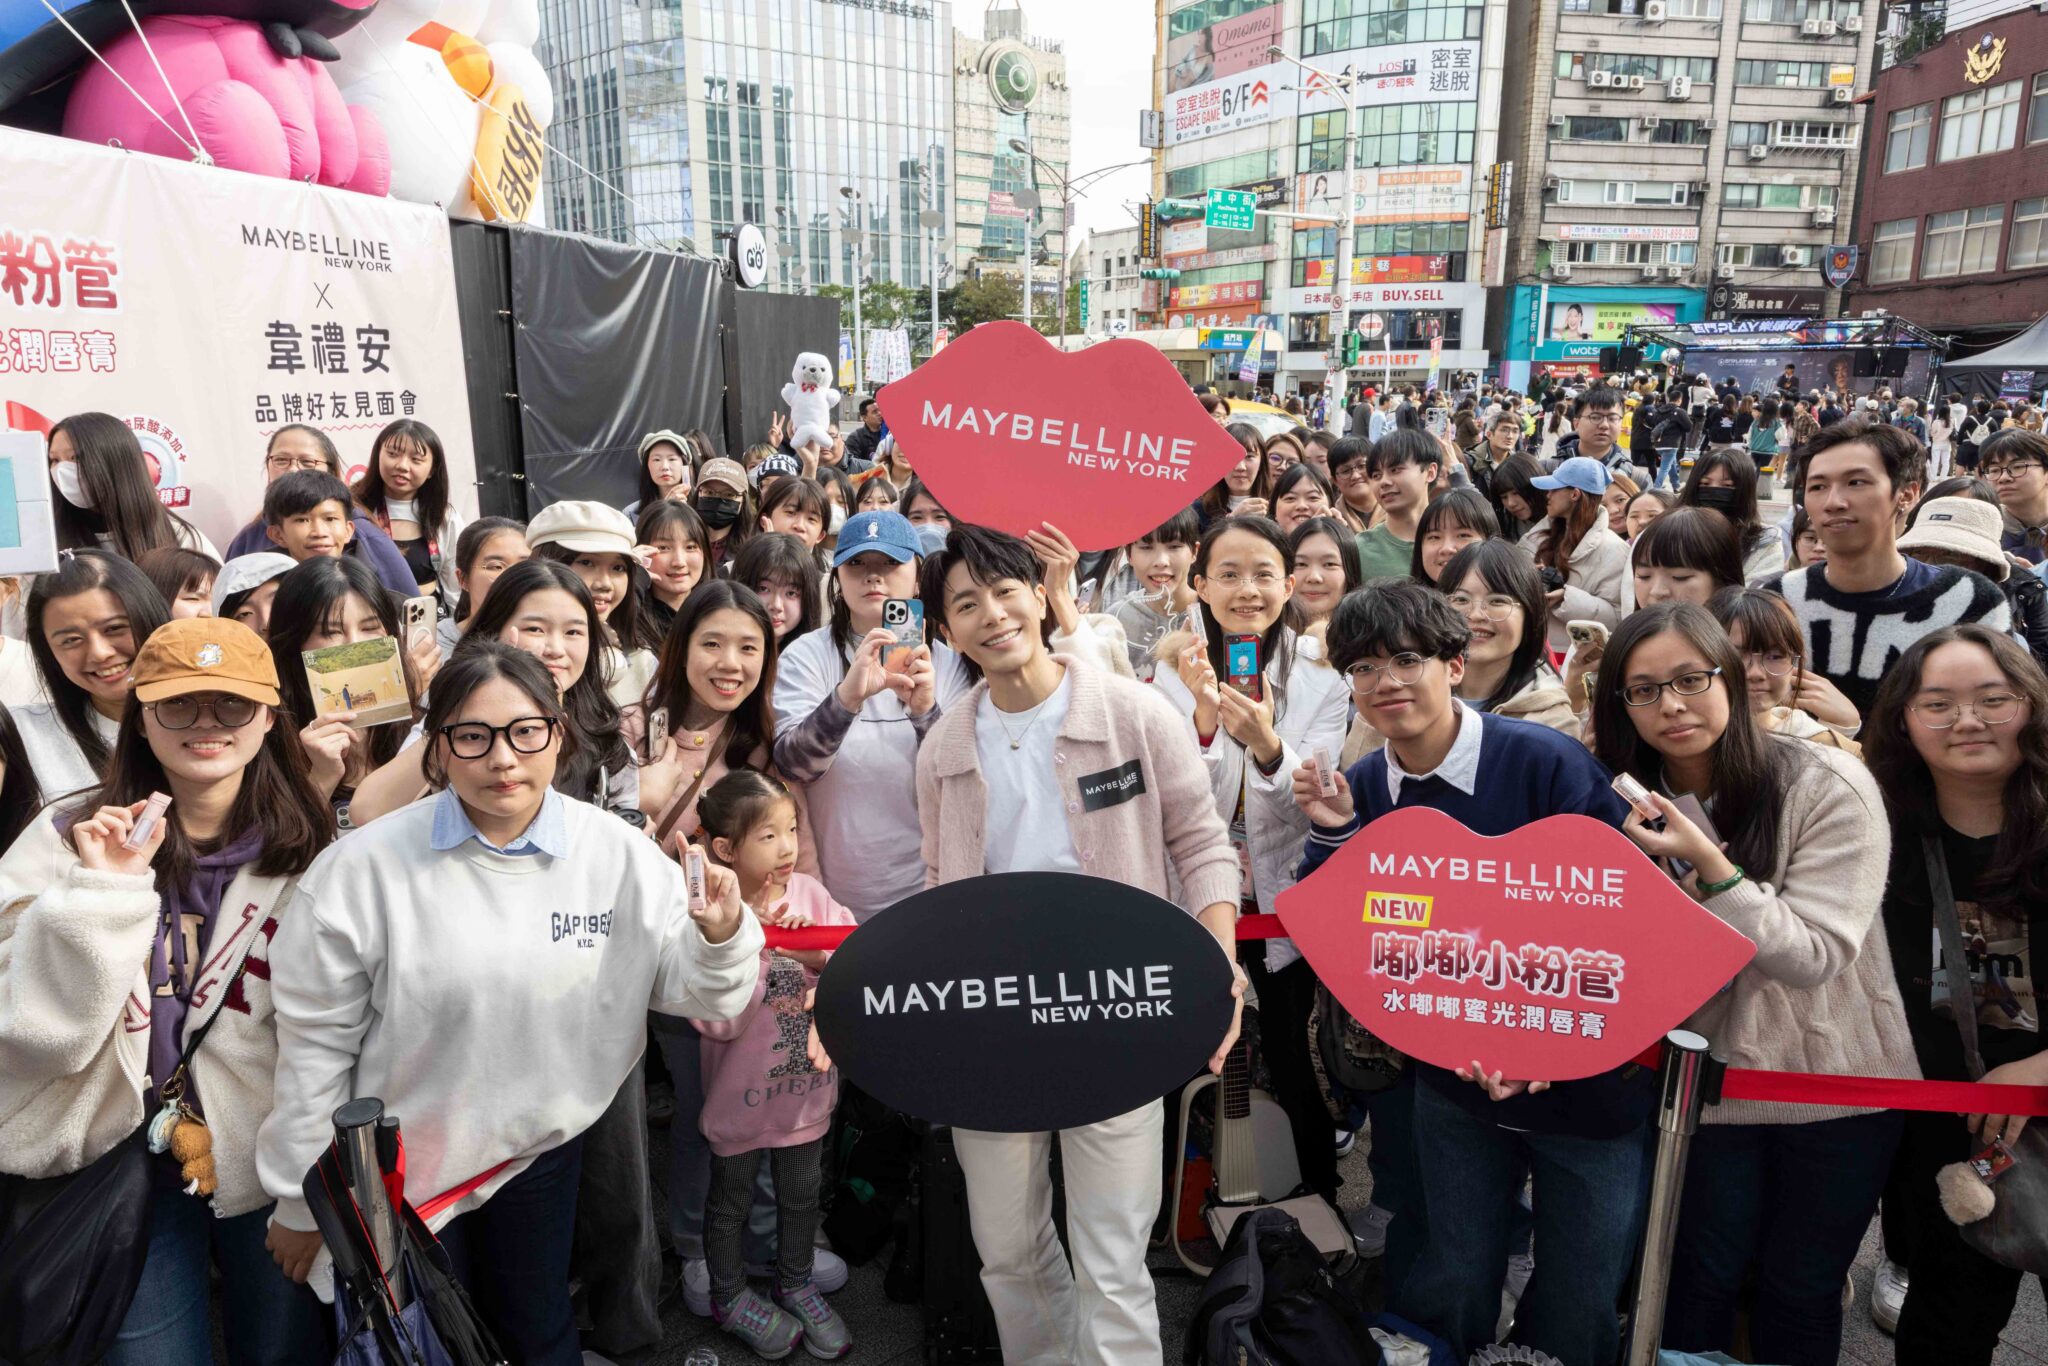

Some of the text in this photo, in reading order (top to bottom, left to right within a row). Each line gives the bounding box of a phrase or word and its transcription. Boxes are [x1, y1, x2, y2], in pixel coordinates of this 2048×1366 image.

[1431, 47, 1472, 70] 密室
[1429, 70, 1470, 92] 逃脫
[1176, 88, 1221, 115] 密室逃脫
[1222, 83, 1251, 116] 6/F
[1176, 111, 1201, 131] ESCAPE
[1201, 108, 1221, 124] GAME
[1213, 191, 1252, 206] 漢中街
[241, 224, 391, 260] MAYBELLINE
[324, 256, 393, 273] NEW YORK
[264, 319, 391, 375] 韋禮安
[255, 389, 417, 423] 品牌好友見面會
[921, 400, 1195, 466] MAYBELLINE
[1067, 450, 1188, 483] NEW YORK
[1085, 772, 1138, 796] MAYBELLINE
[1370, 852, 1624, 893] MAYBELLINE
[1370, 898, 1427, 922] NEW
[1504, 886, 1623, 908] NEW YORK
[1371, 930, 1624, 1003] 嘟嘟小粉管
[863, 965, 1172, 1016] MAYBELLINE
[1031, 999, 1175, 1024] NEW YORK
[1383, 988, 1606, 1039] 水嘟嘟蜜光潤唇膏
